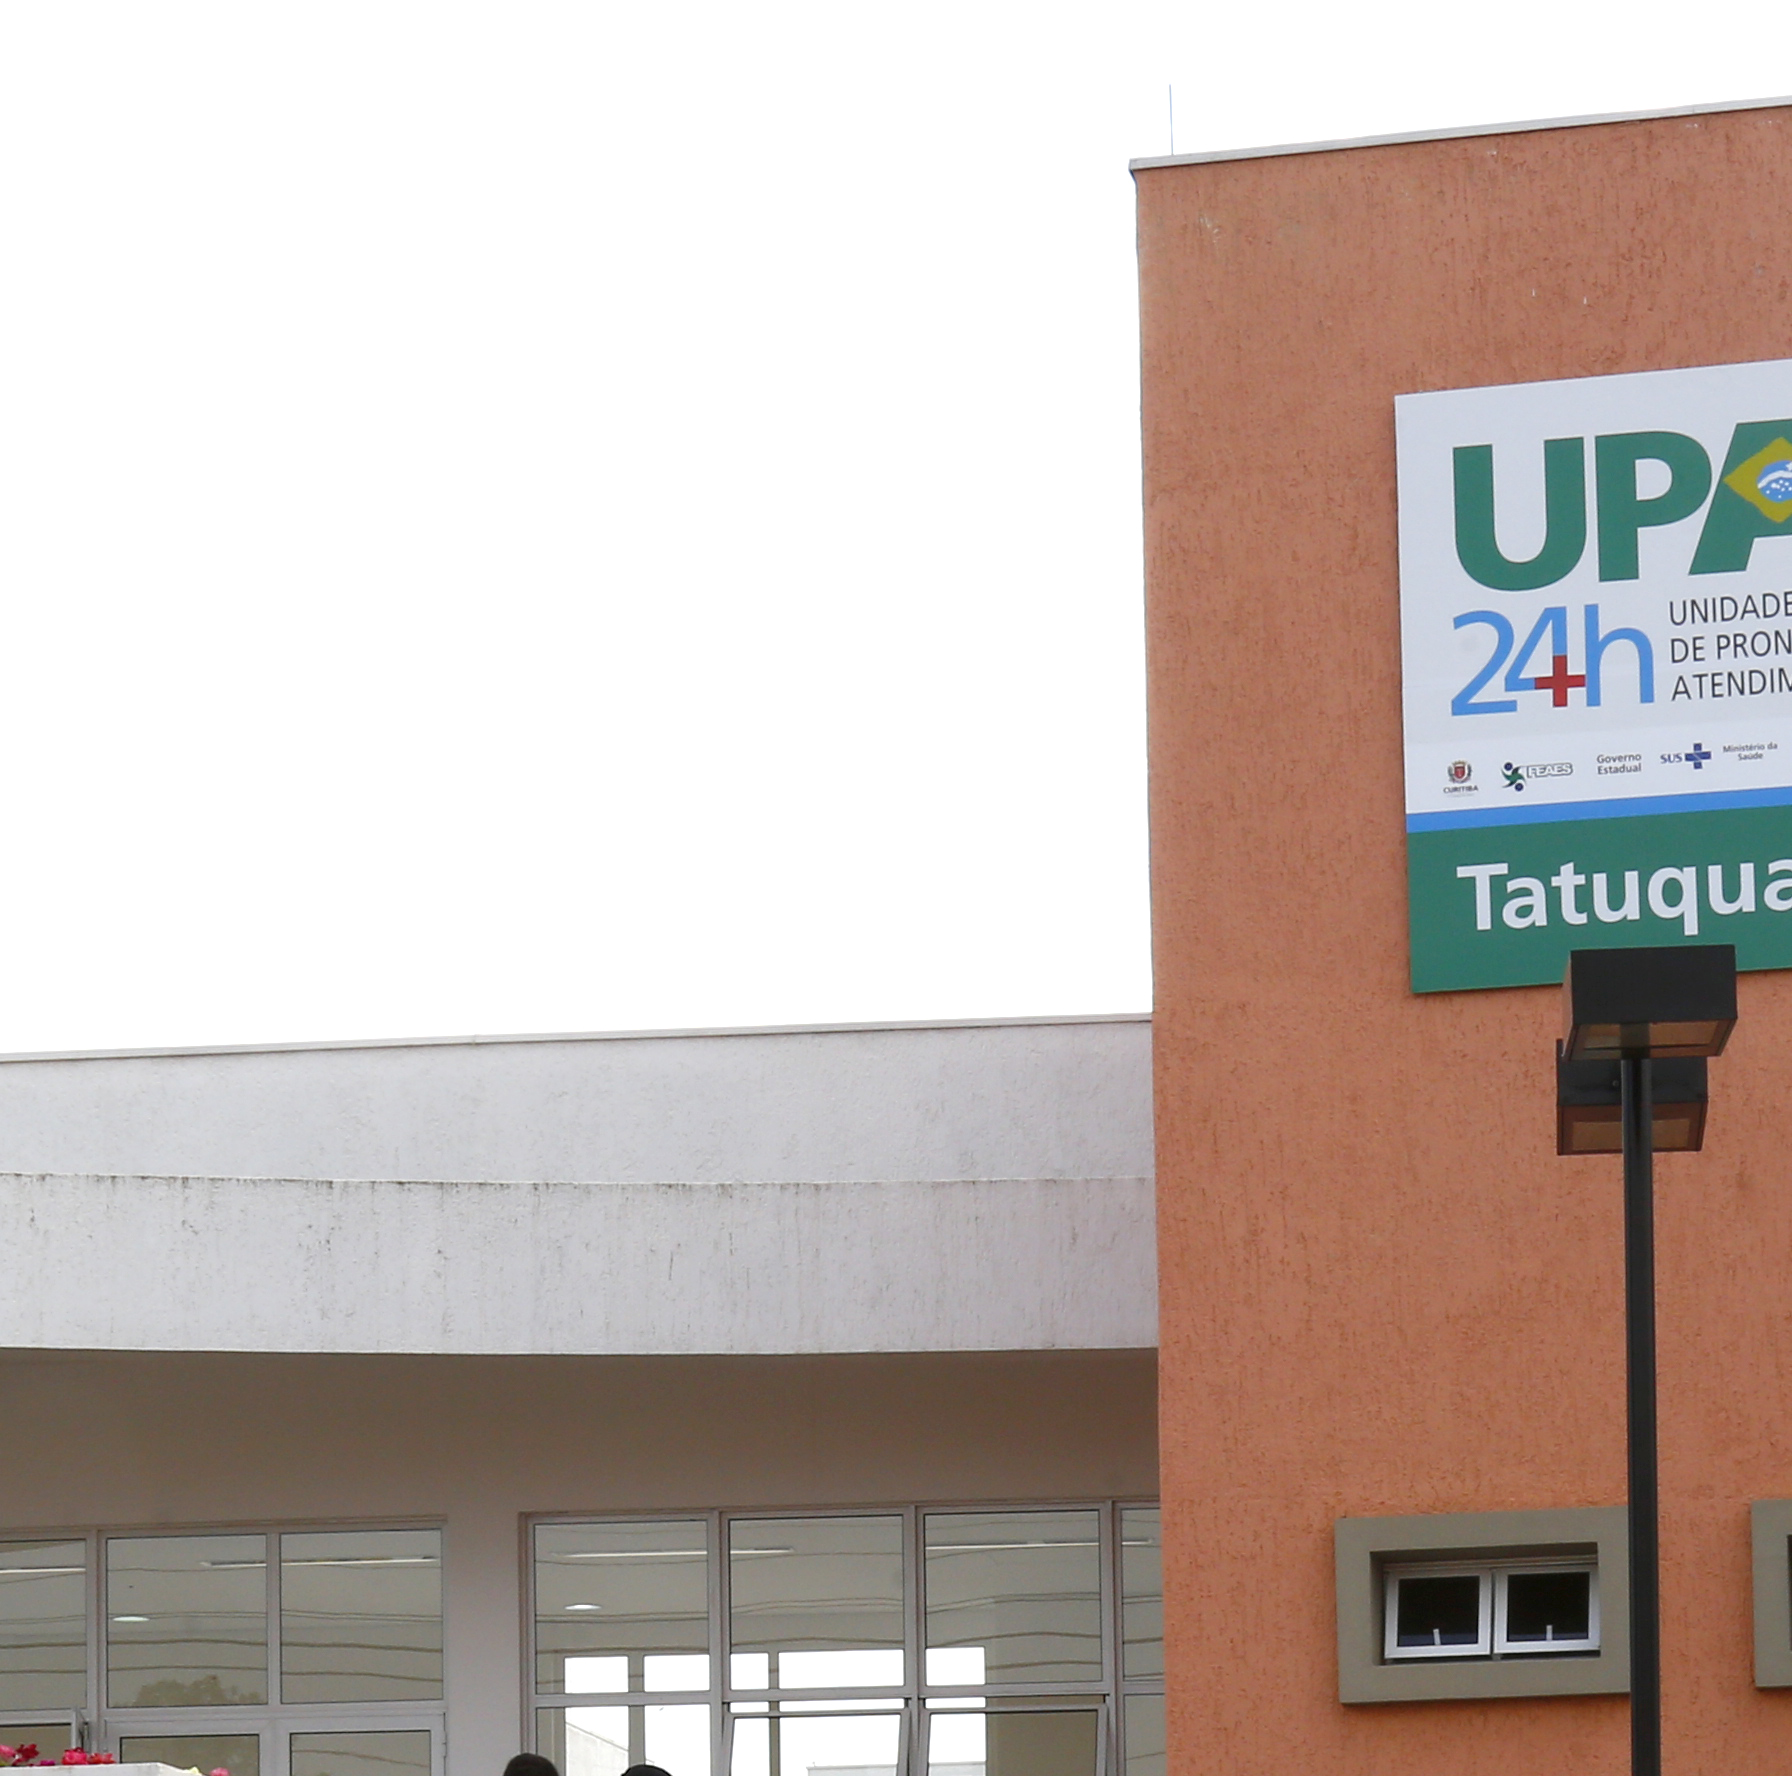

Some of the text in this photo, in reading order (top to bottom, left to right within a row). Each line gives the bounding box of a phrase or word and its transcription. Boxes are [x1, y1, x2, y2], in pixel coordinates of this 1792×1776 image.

[1670, 635, 1706, 664] DE
[1451, 604, 1655, 716] 24h
[1722, 742, 1778, 752] Ministério da
[1596, 753, 1642, 764] Governo
[1660, 753, 1683, 764] SUS
[1738, 752, 1763, 761] Saúde
[1527, 762, 1573, 778] FEAES
[1597, 763, 1642, 775] Estadual
[1443, 785, 1479, 794] CURITIBA
